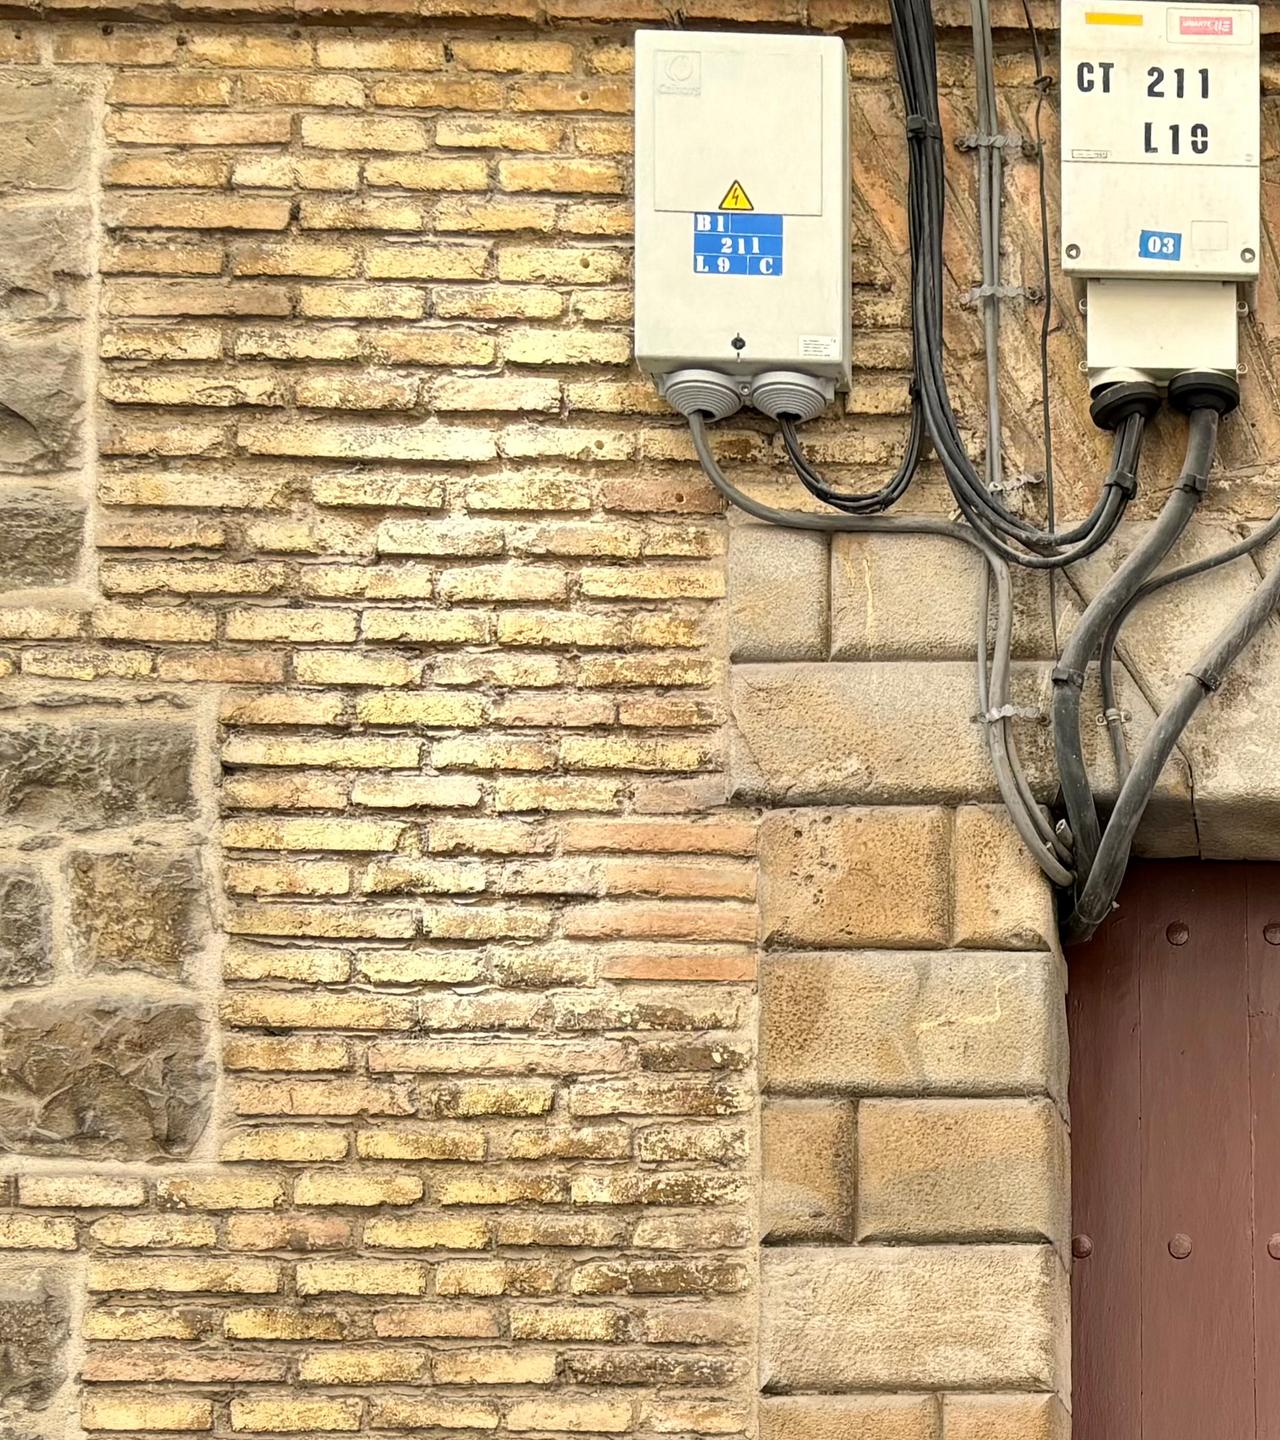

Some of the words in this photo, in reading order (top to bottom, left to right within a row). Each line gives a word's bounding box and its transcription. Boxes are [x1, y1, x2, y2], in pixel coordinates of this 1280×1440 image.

[1077, 61, 1114, 93] CT
[1147, 66, 1209, 99] 211
[721, 236, 760, 255] 211
[1147, 235, 1176, 255] 03
[759, 257, 774, 275] C
